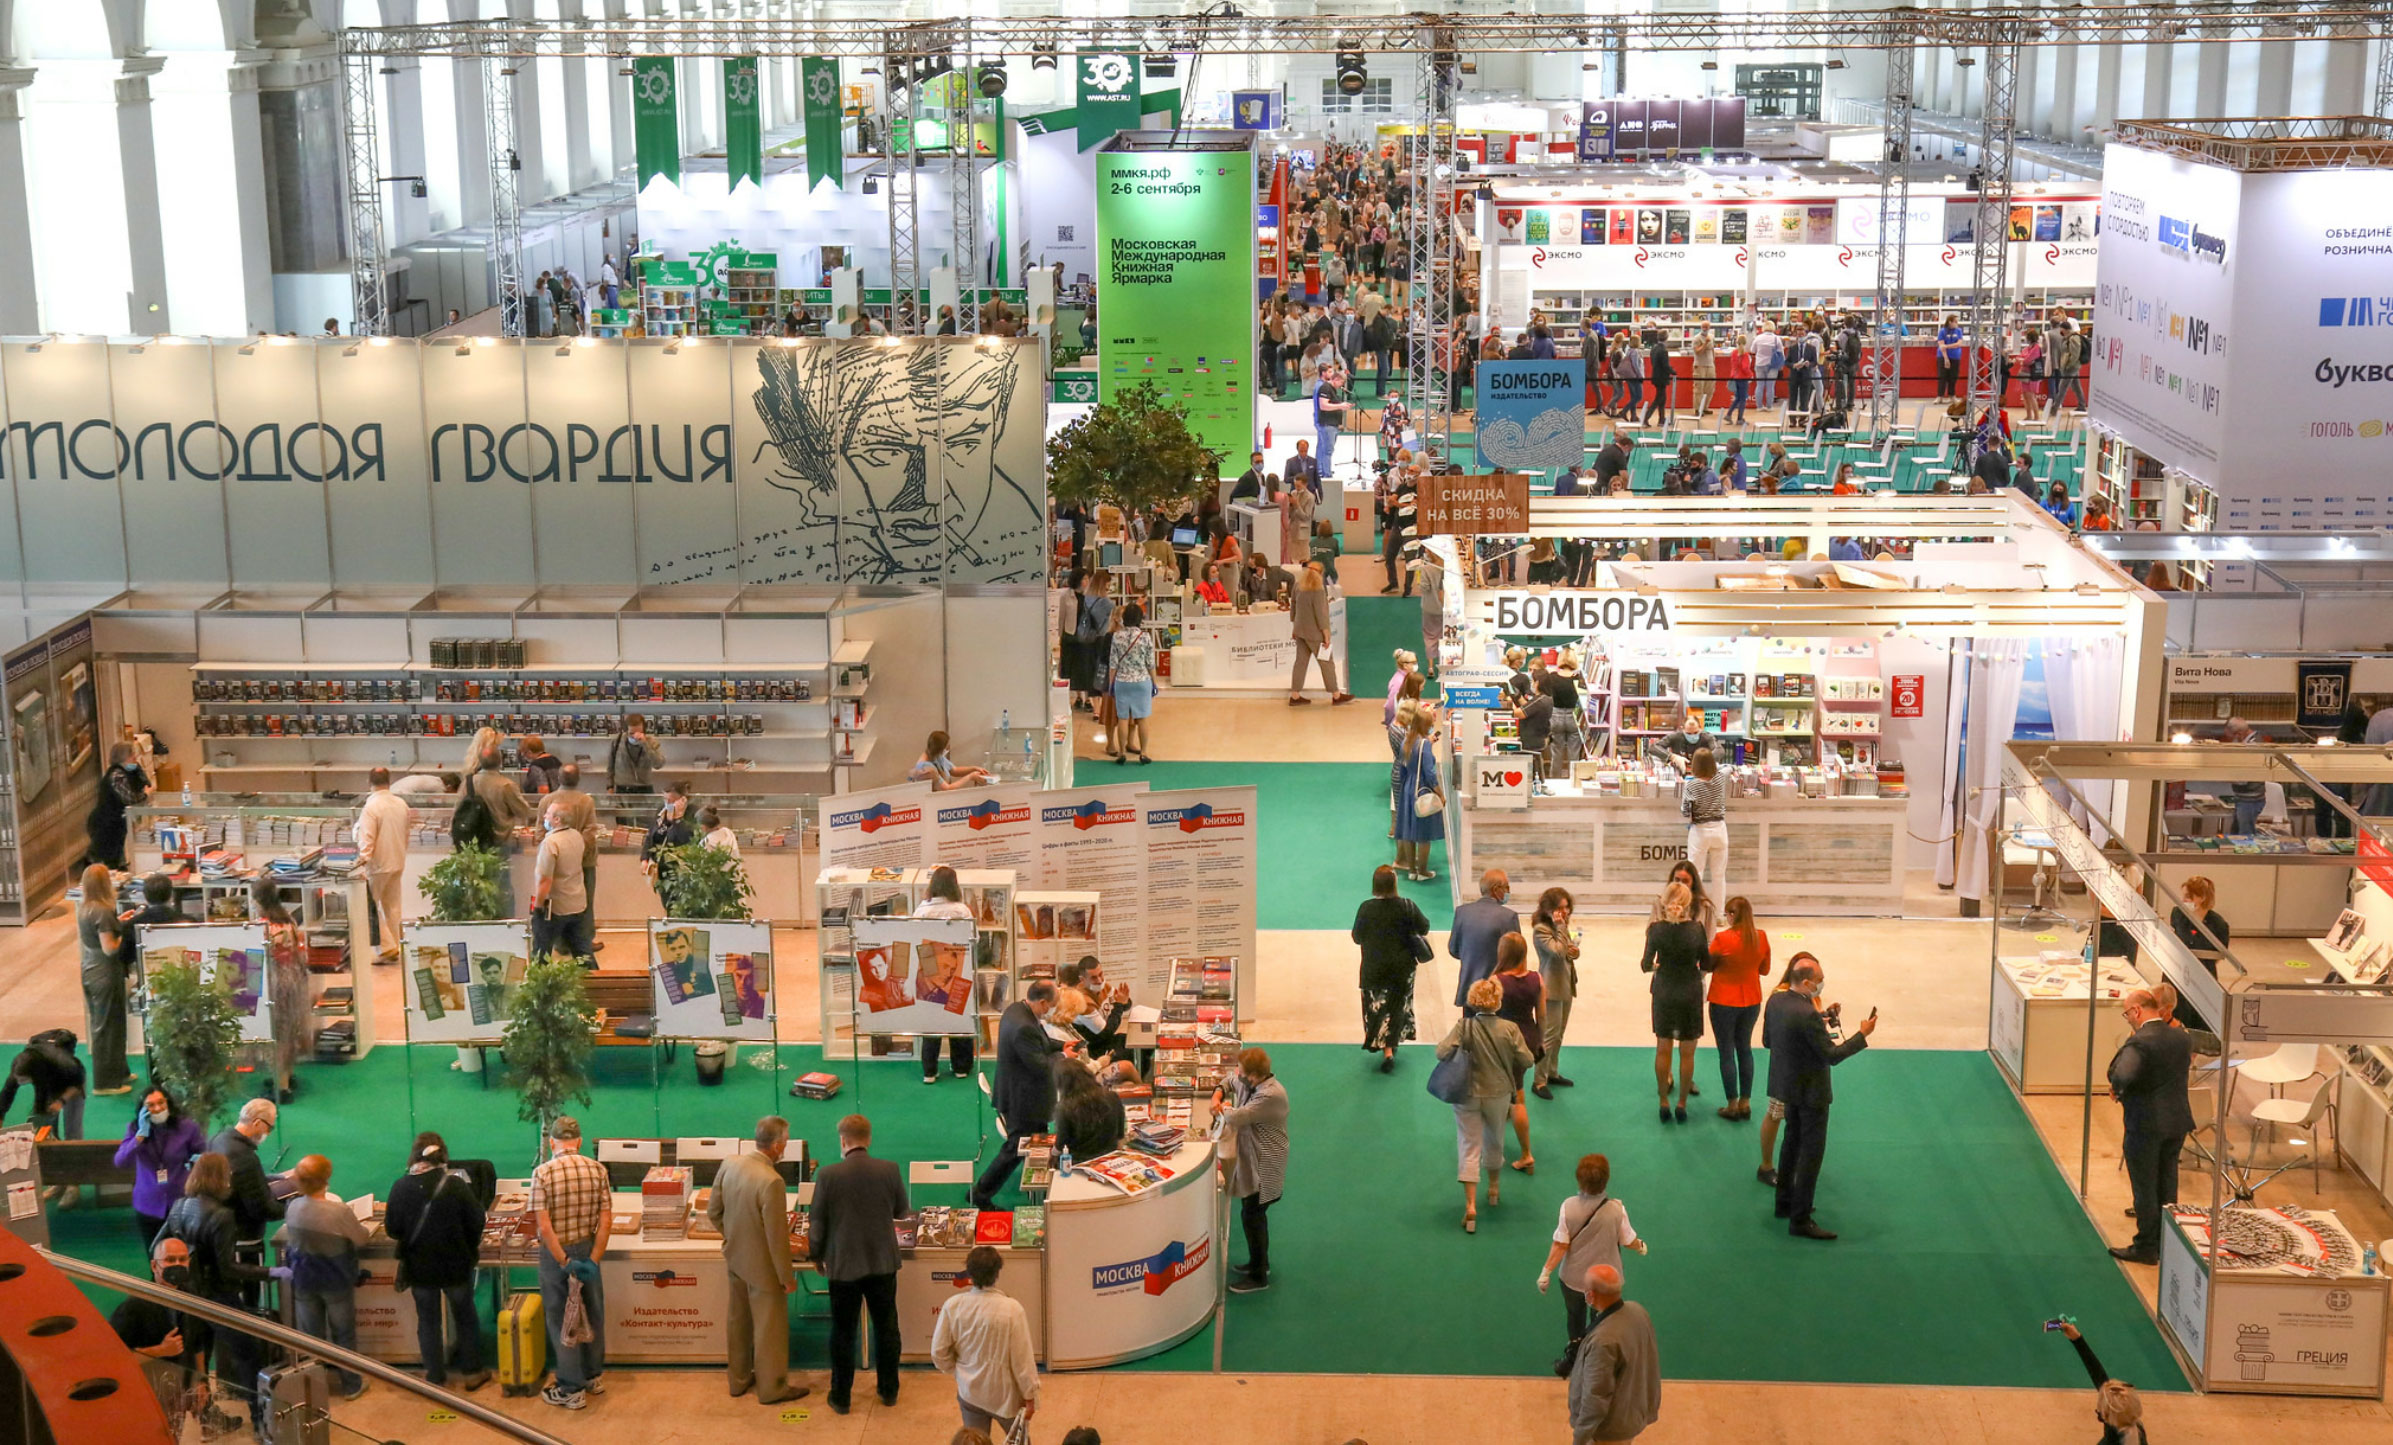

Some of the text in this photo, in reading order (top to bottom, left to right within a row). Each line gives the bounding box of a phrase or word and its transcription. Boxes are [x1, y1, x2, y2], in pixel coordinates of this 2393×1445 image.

[1111, 167, 1171, 180] ммкя.рф
[1111, 182, 1201, 196] 2-6 сентября
[2325, 225, 2392, 239] ОБЪЕДИНЁ
[1111, 239, 1197, 249] Московская
[2324, 245, 2392, 256] РОЗНИЧНА
[1111, 250, 1226, 263] Международная
[1548, 251, 1583, 259] ЭКСМО
[1651, 251, 1685, 259] ЭКСМО
[2062, 248, 2097, 256] ЭКСМО
[1111, 261, 1174, 272] Книжная
[1111, 272, 1172, 286] Ярмарка
[2187, 315, 2209, 355] №1
[1491, 373, 1572, 389] БОМБОРА
[2202, 383, 2219, 417] №1
[2311, 421, 2355, 438] ГОГОЛЬ
[1442, 489, 1506, 503] СКИДКА
[1427, 506, 1520, 521] НА ВСЁ 30%
[1498, 596, 1669, 630] БОМБОРА
[1231, 642, 1283, 653] БИБЛИОТЕКИ
[2175, 667, 2232, 677] Вита Нова
[832, 811, 919, 825] МОСКВА КНИЖНАЯ
[939, 809, 1029, 822] МОСКВА КНИЖНАЯ
[1043, 809, 1136, 823] МОСКВА КНИЖНАЯ
[1149, 811, 1242, 826] МОСКВА КНИЖНАЯ
[1641, 845, 1688, 860] БОМБ
[1096, 1263, 1150, 1284] МОСКВА
[634, 1307, 699, 1315] Издательство
[620, 1320, 713, 1329] «Контакт-культура»
[2297, 1350, 2348, 1365] ГРЕЦИЯ
